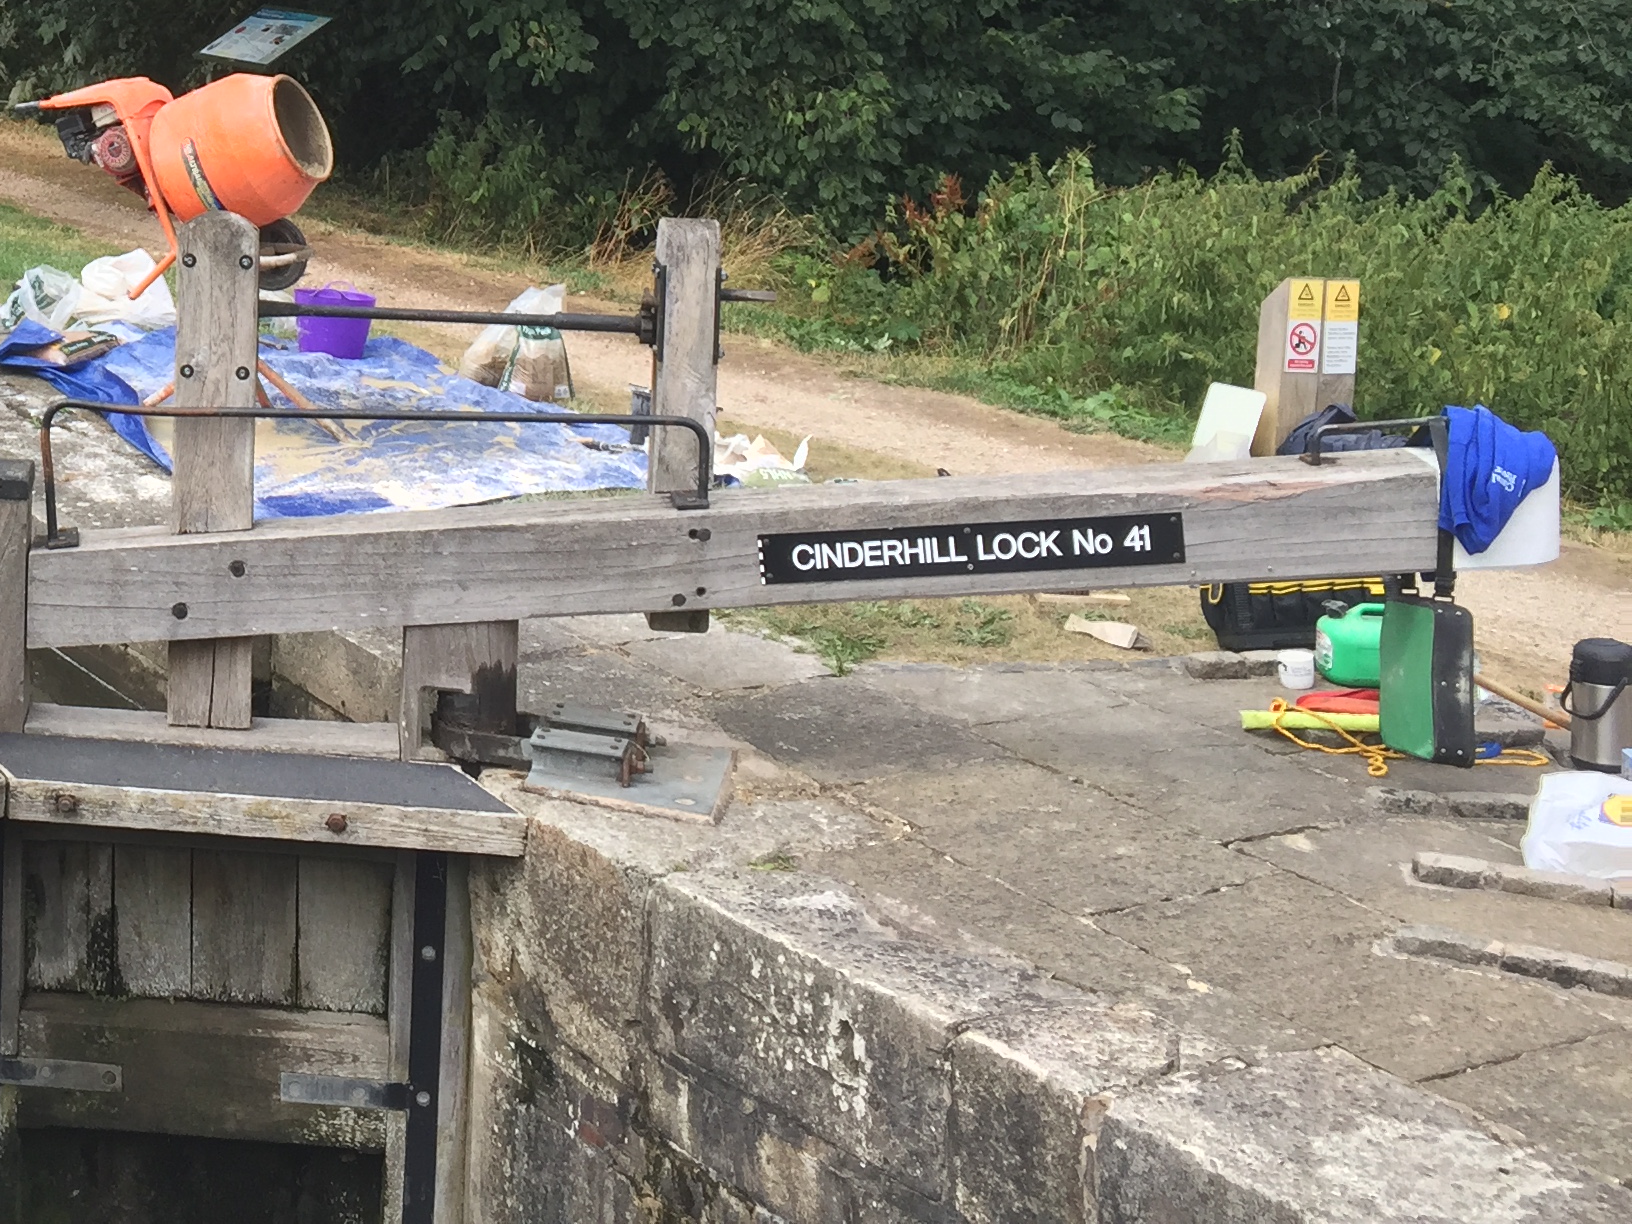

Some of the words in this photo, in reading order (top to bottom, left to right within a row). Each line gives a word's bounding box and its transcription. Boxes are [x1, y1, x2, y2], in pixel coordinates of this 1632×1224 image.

[791, 535, 968, 571] CINDERHILL
[976, 530, 1064, 561] LOCK
[1071, 528, 1114, 556] No
[1123, 524, 1152, 552] 41
